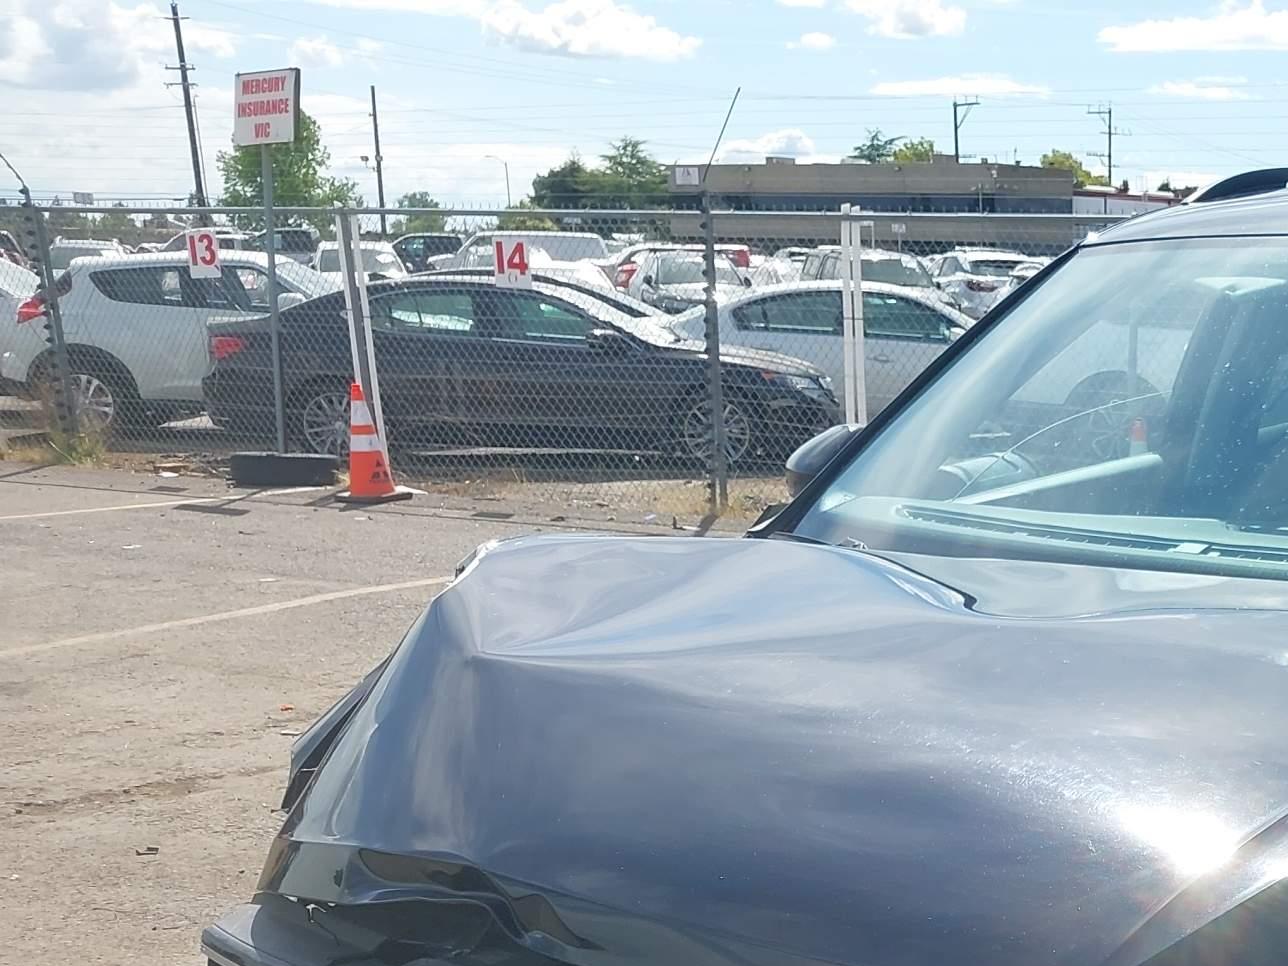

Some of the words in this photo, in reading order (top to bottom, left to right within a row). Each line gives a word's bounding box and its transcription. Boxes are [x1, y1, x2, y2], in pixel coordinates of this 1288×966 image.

[241, 76, 287, 96] MERCURY
[237, 98, 290, 118] INSURANCE
[254, 122, 271, 138] VIC
[189, 234, 216, 266] 13
[496, 241, 529, 275] 14
